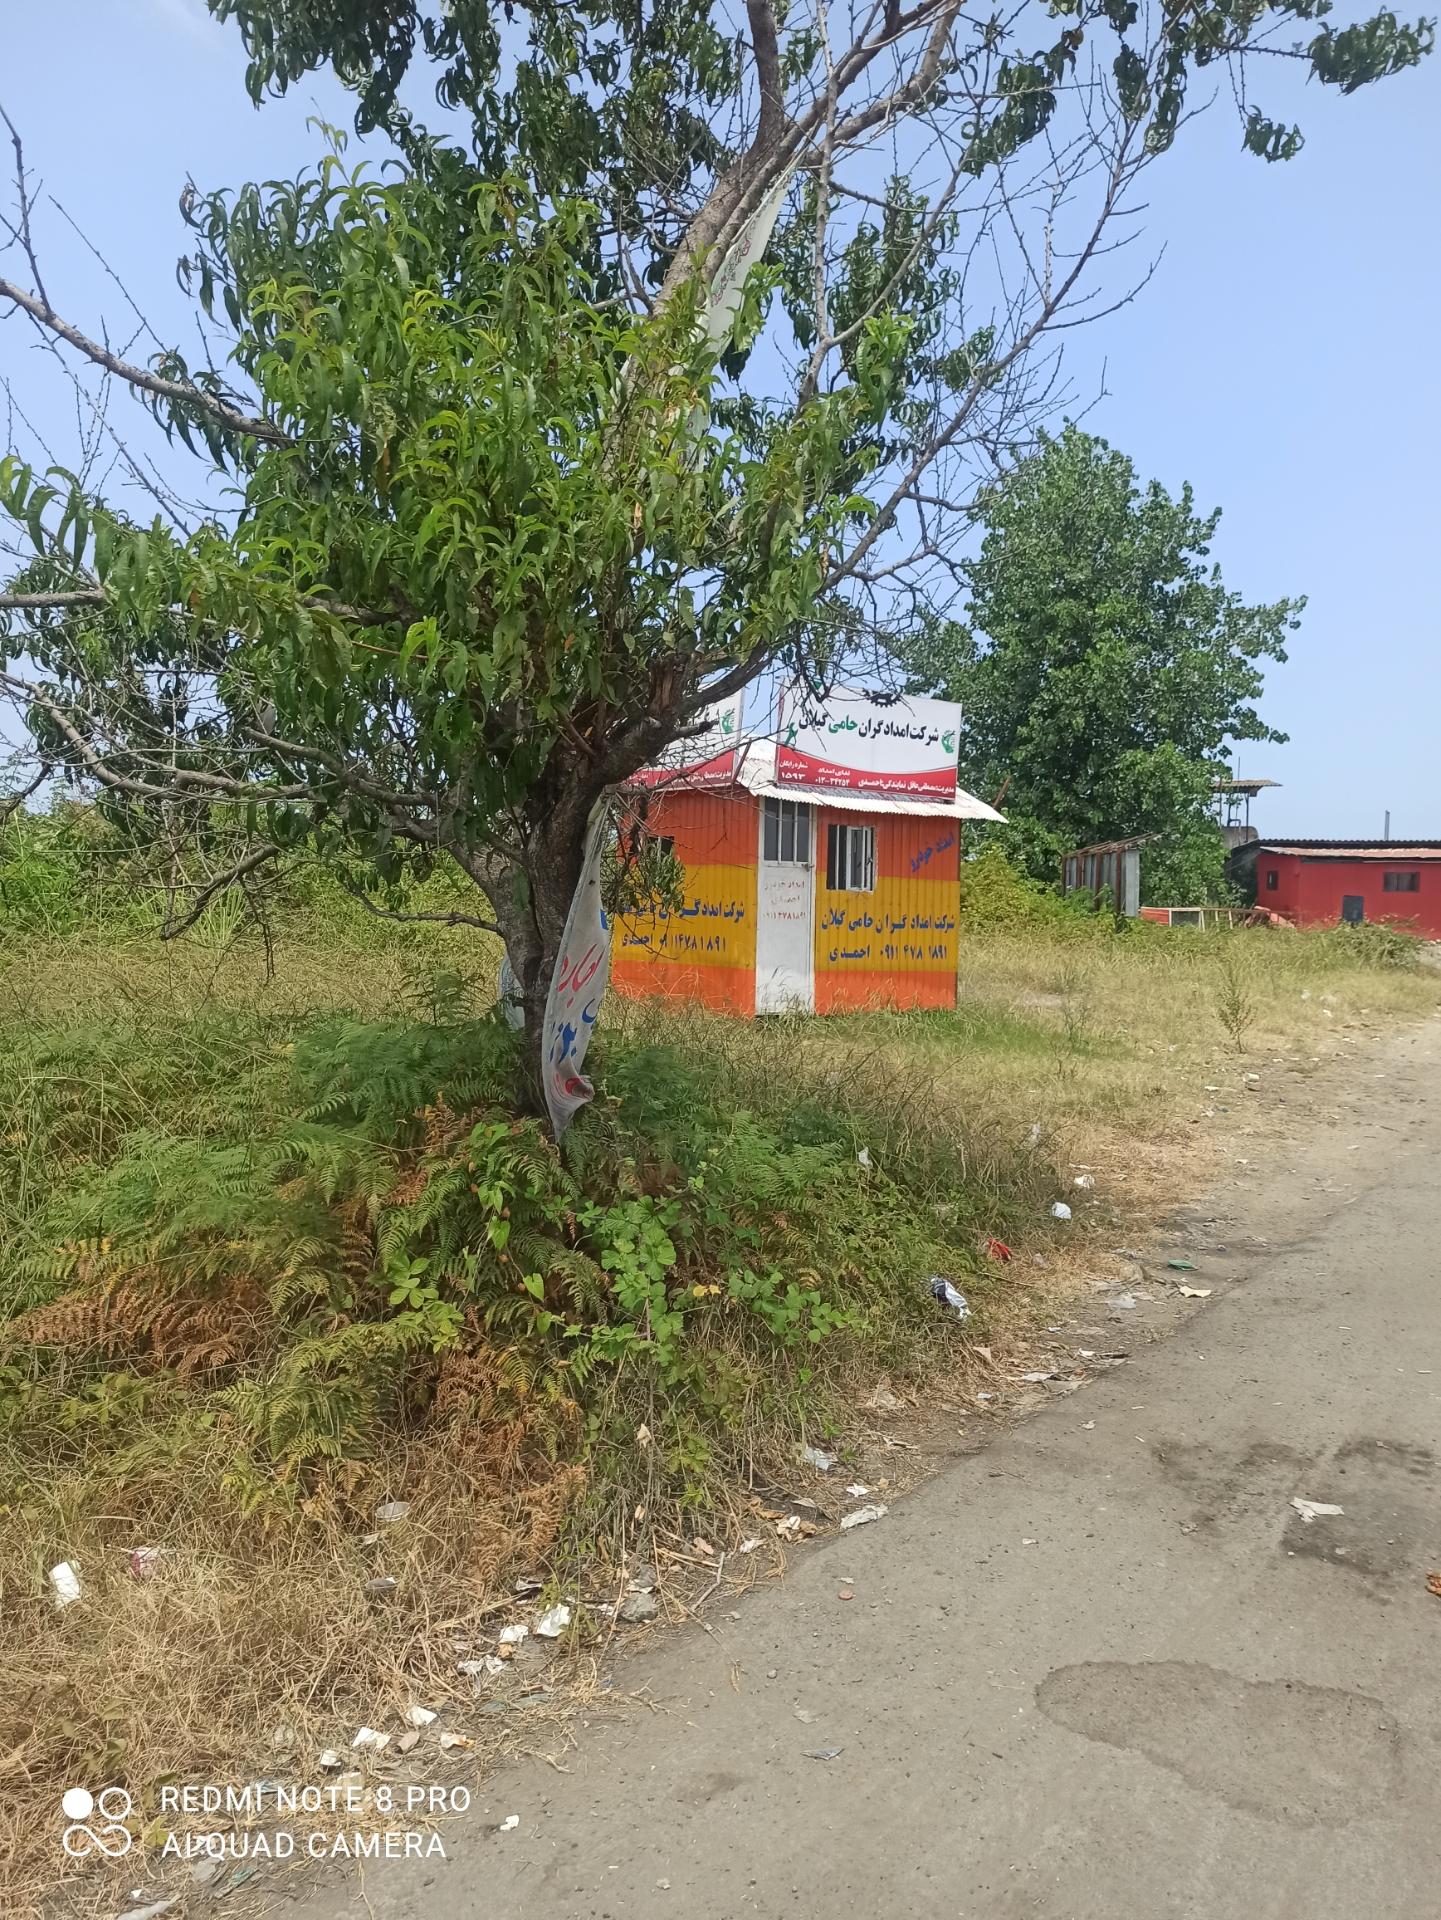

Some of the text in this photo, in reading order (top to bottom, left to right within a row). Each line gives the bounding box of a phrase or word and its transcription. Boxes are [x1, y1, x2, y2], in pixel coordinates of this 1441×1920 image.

[798, 708, 829, 730] گیلان
[828, 714, 858, 733] حامی
[909, 725, 939, 746] شرکت
[723, 900, 745, 923] شرکت
[848, 911, 874, 931] حامی
[934, 914, 955, 933] شرکت
[829, 944, 870, 961] احمدی
